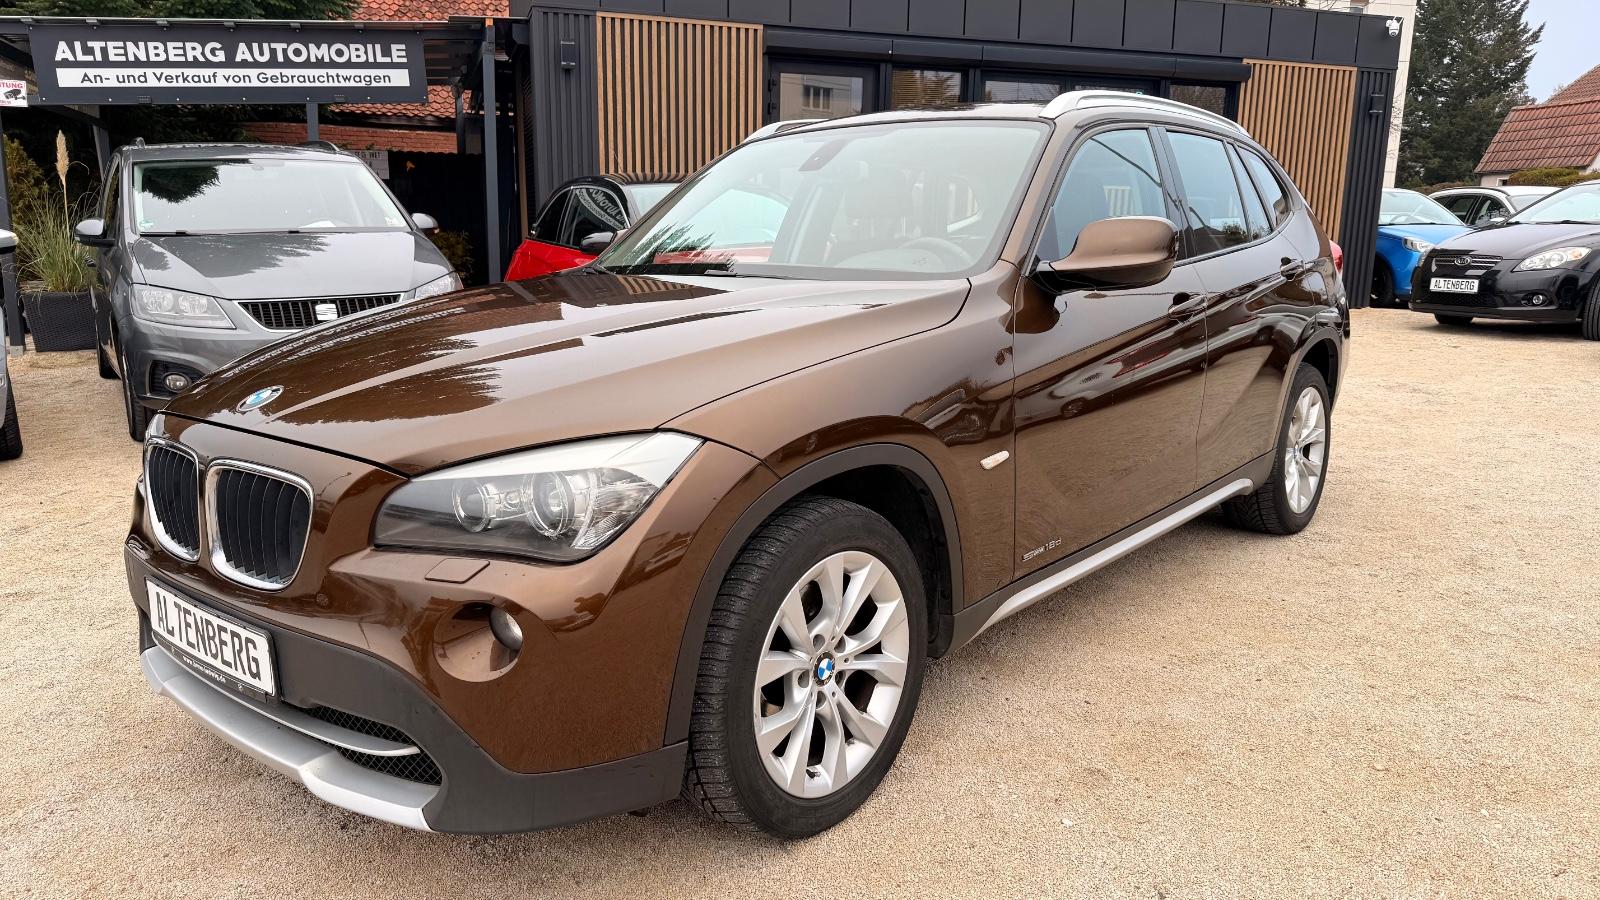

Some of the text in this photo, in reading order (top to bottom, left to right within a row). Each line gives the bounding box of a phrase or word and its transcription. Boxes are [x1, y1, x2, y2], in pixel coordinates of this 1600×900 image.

[54, 40, 408, 63] ALTENBERG AUTOMOBILE
[80, 71, 392, 86] An- und Verkauf von Gebrauchtwagen
[1433, 279, 1475, 290] ALTENBERG
[155, 591, 262, 681] ALTENBERG
